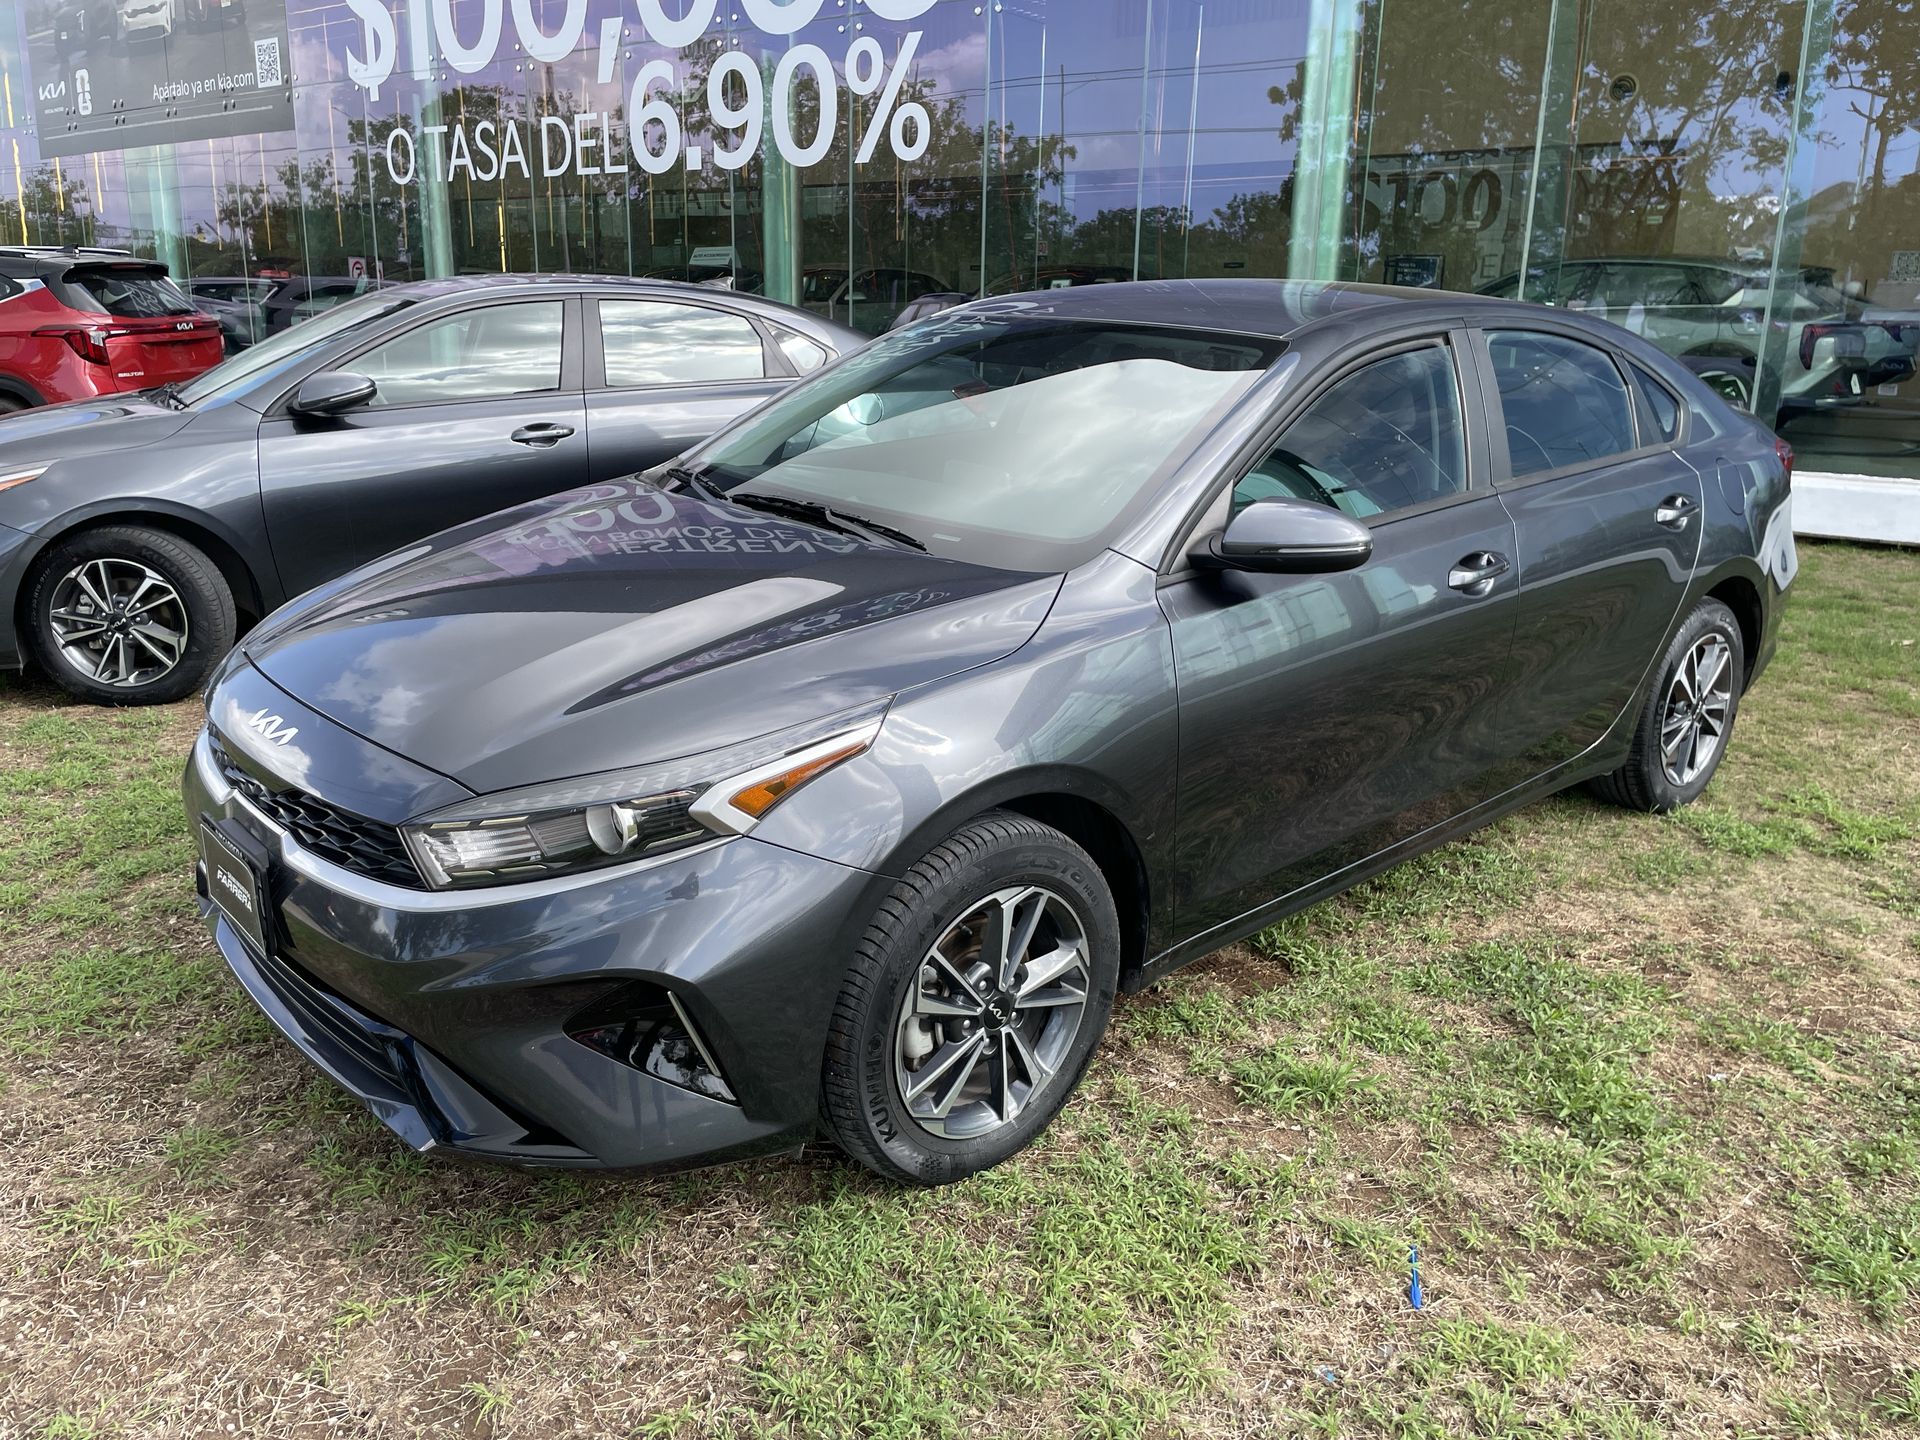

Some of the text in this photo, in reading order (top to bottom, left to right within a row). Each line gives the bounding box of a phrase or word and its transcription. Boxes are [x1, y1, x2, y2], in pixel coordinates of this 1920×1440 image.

[346, 0, 941, 102] $100,
[153, 72, 255, 103] Apártalo ya en kia.com
[386, 30, 931, 185] O TASA DEL 6.90%
[249, 708, 299, 746] KIA
[217, 869, 253, 912] FARRERA
[866, 1032, 899, 1143] KUMHO
